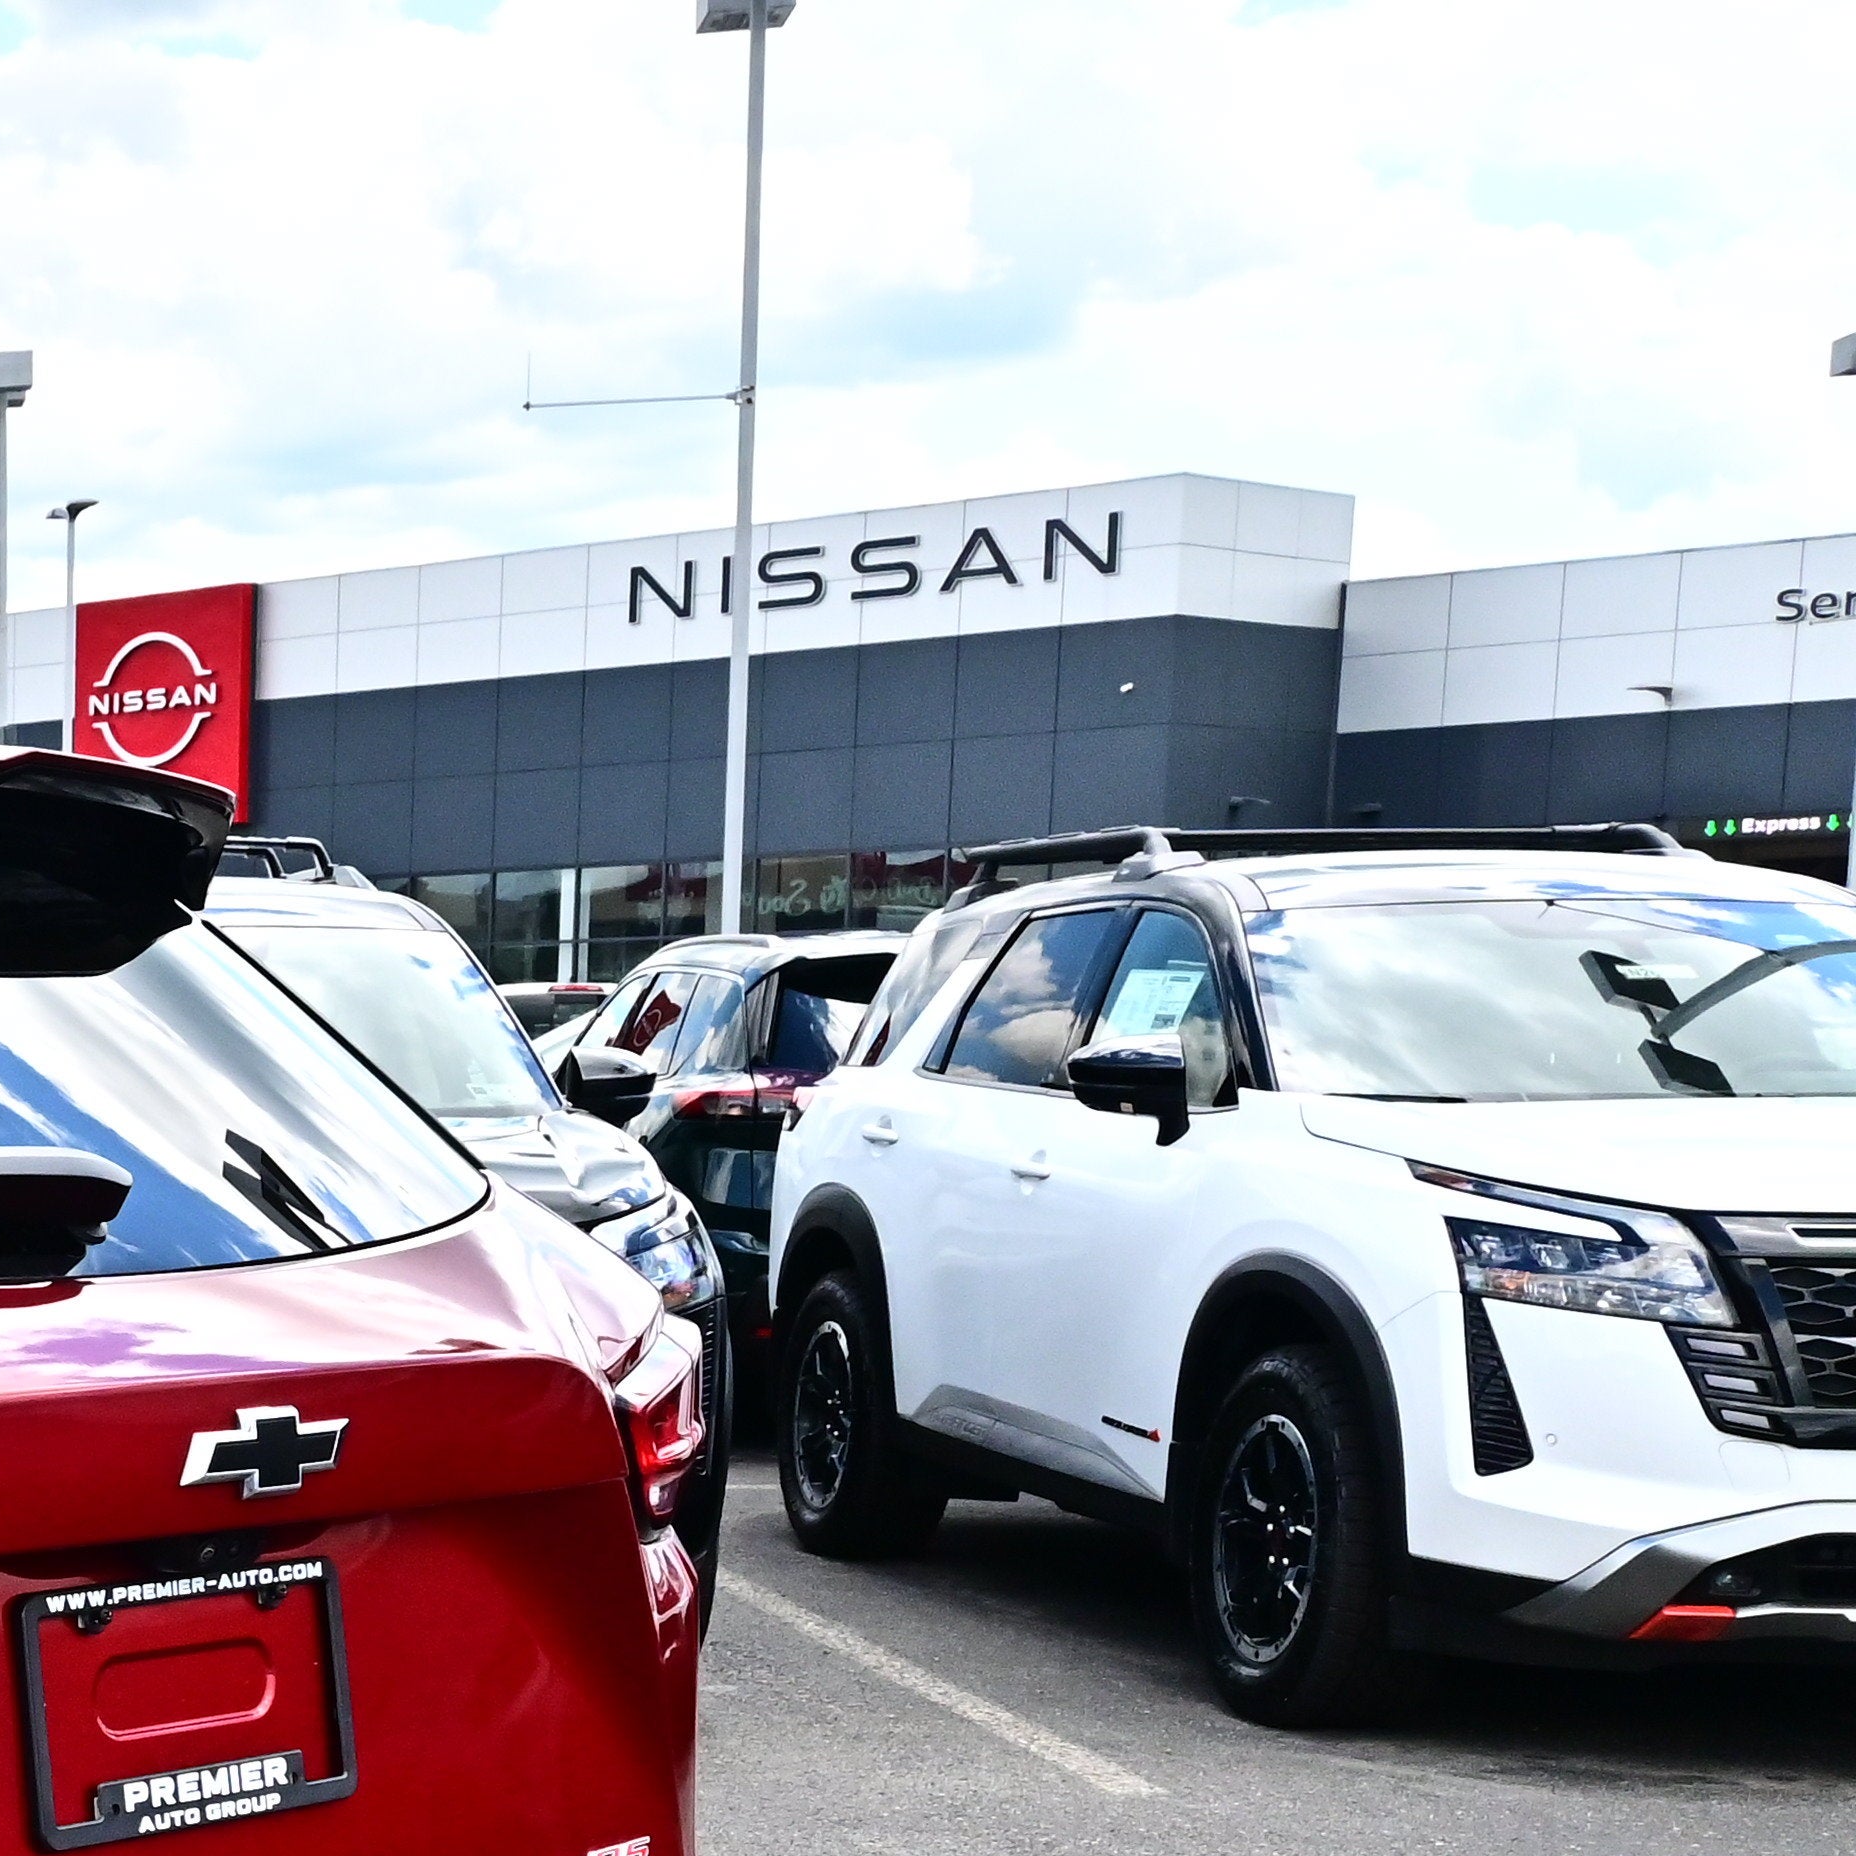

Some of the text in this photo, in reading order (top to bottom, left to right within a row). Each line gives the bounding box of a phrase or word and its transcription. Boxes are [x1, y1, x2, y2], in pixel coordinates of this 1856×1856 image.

[628, 511, 1123, 625] NISSAN
[88, 682, 217, 716] NISSAN
[1741, 816, 1822, 836] Express
[46, 1562, 323, 1613] WWW.PREMIER-AUTO.COM
[123, 1756, 289, 1813] PREMIER
[138, 1792, 281, 1833] AUTO GROUP
